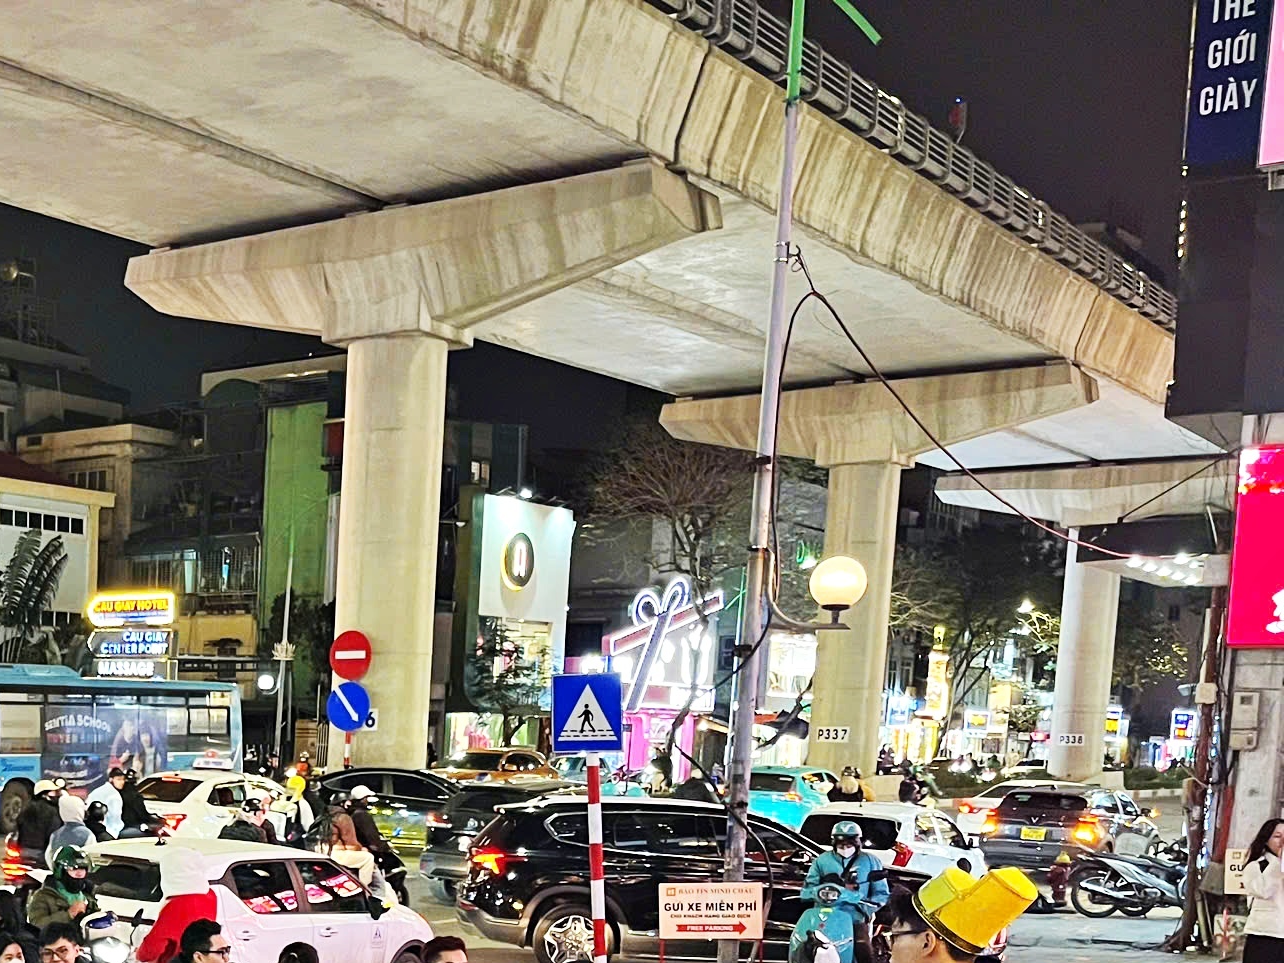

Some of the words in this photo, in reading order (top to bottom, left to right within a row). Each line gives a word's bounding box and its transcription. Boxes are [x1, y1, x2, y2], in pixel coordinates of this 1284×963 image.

[1207, 28, 1256, 69] GIỚI
[1199, 76, 1257, 116] GIÀY
[137, 599, 168, 612] HOTEL
[123, 631, 144, 643] CAU
[145, 631, 168, 643] GIAY
[138, 643, 168, 654] POINT
[97, 661, 155, 677] MASSAGE
[44, 714, 76, 731] SENTIA
[77, 714, 111, 733] SCHOOL
[817, 728, 848, 740] P337
[1059, 735, 1083, 744] P338
[687, 902, 702, 911] XE
[738, 900, 757, 911] PHÍ
